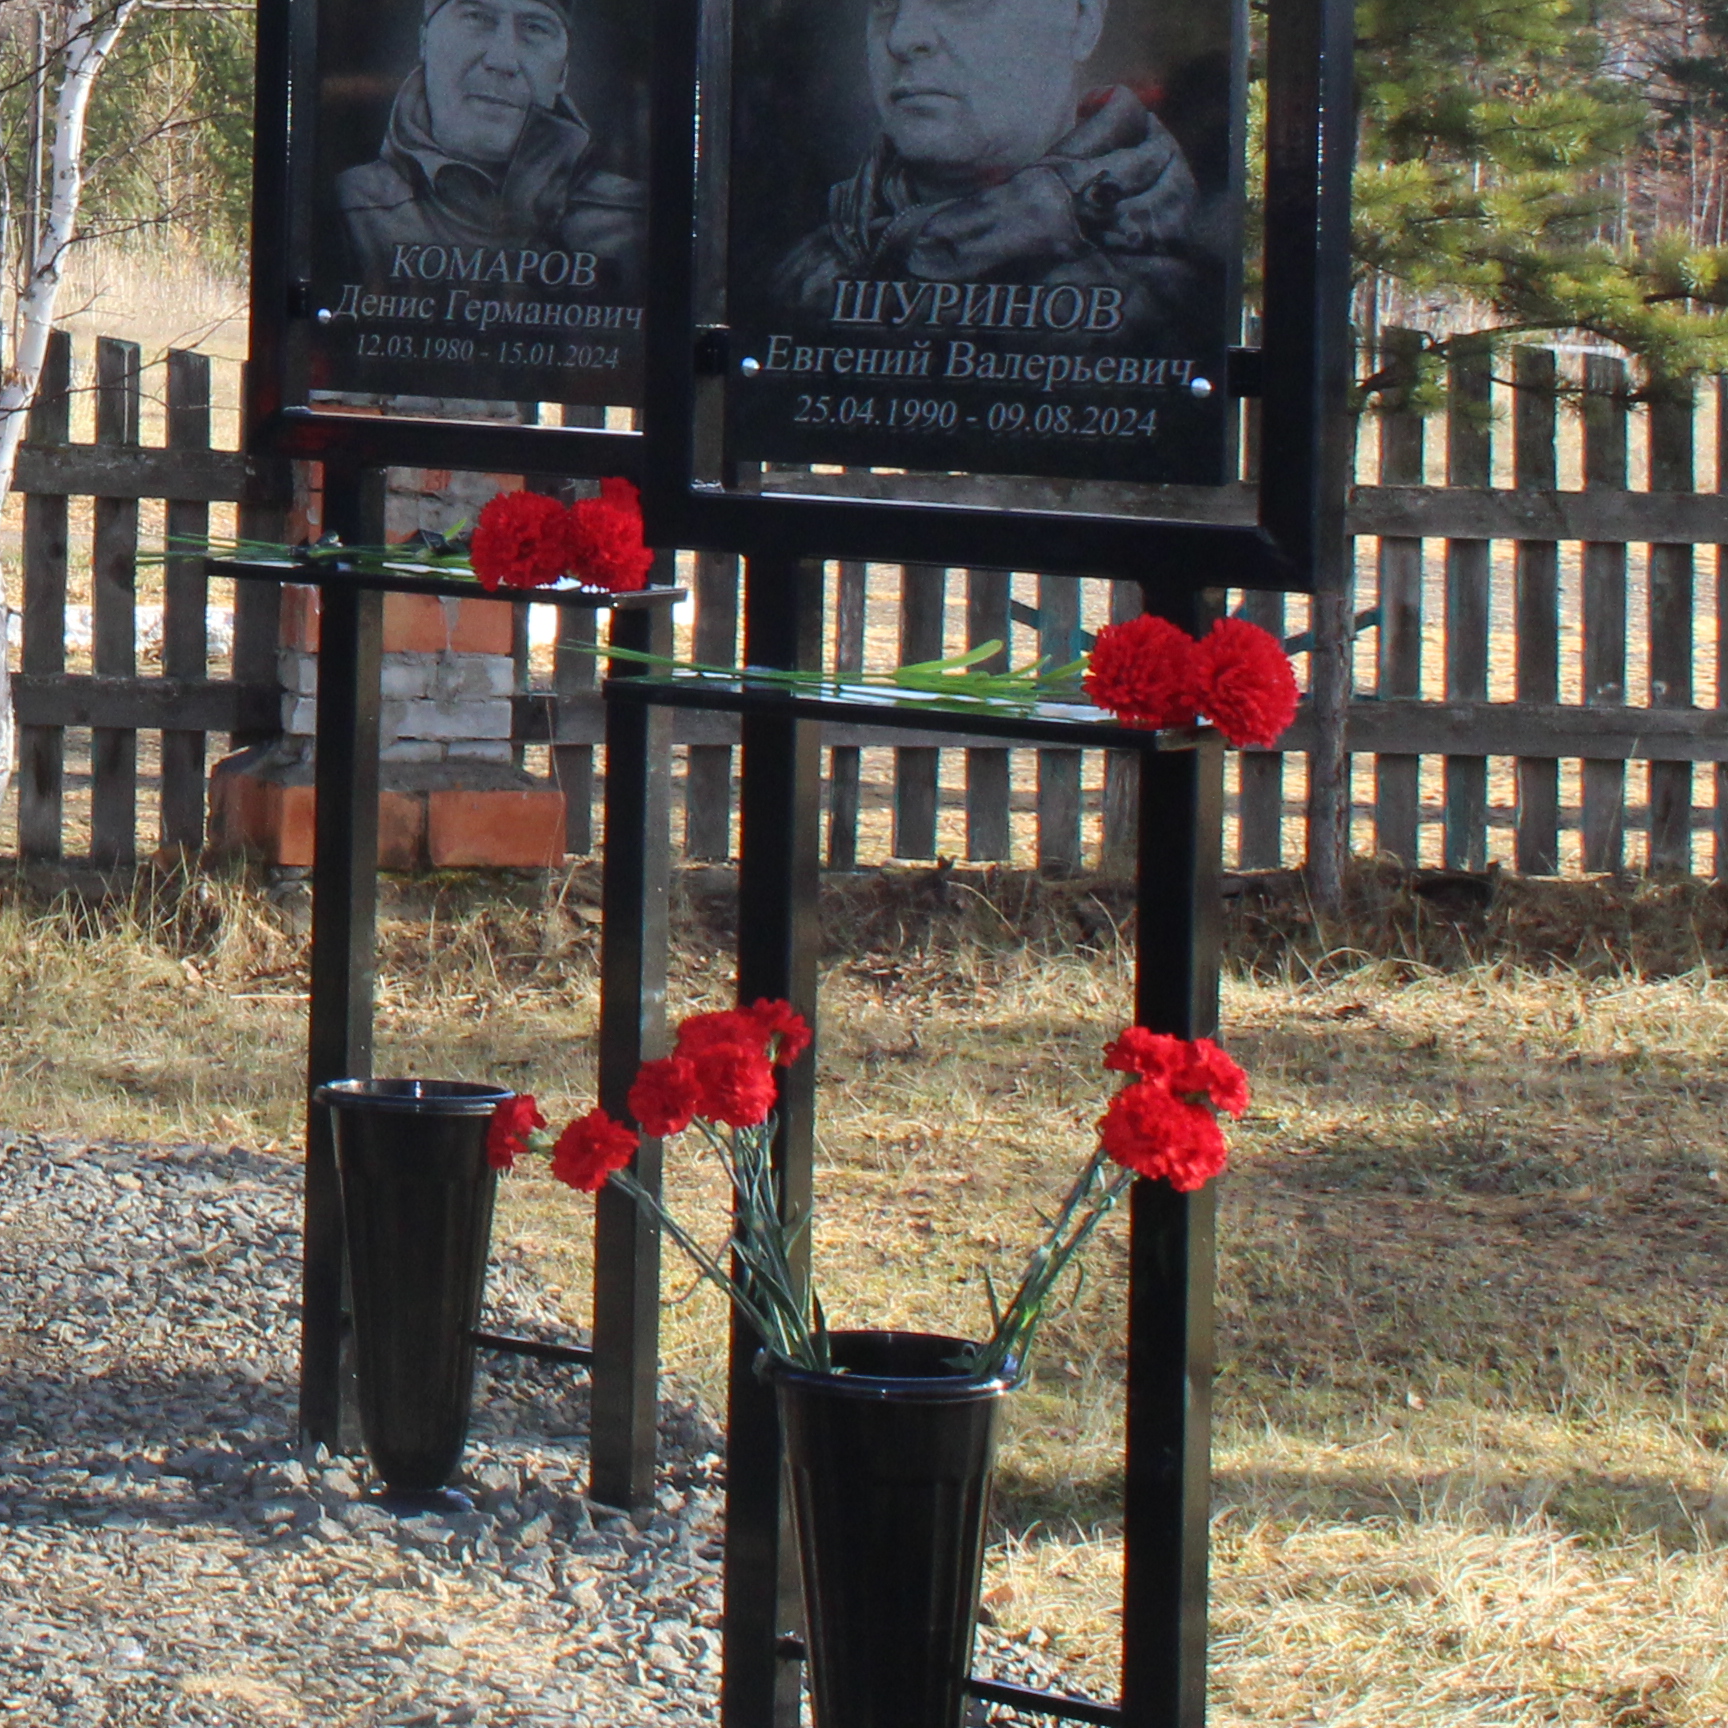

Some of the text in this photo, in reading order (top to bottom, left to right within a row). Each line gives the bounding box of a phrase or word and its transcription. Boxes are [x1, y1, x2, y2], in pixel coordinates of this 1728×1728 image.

[391, 244, 598, 286] КОМАРОВ
[336, 285, 644, 330] Денис Германович
[832, 280, 1123, 330] ШУРИНОВ
[357, 334, 474, 361] 12.03.1980
[498, 341, 619, 369] 15.01.2024
[765, 335, 1195, 391] Евгений Валерьевич
[794, 395, 957, 429] 25.04.1990
[988, 402, 1157, 437] 09.08.2024
